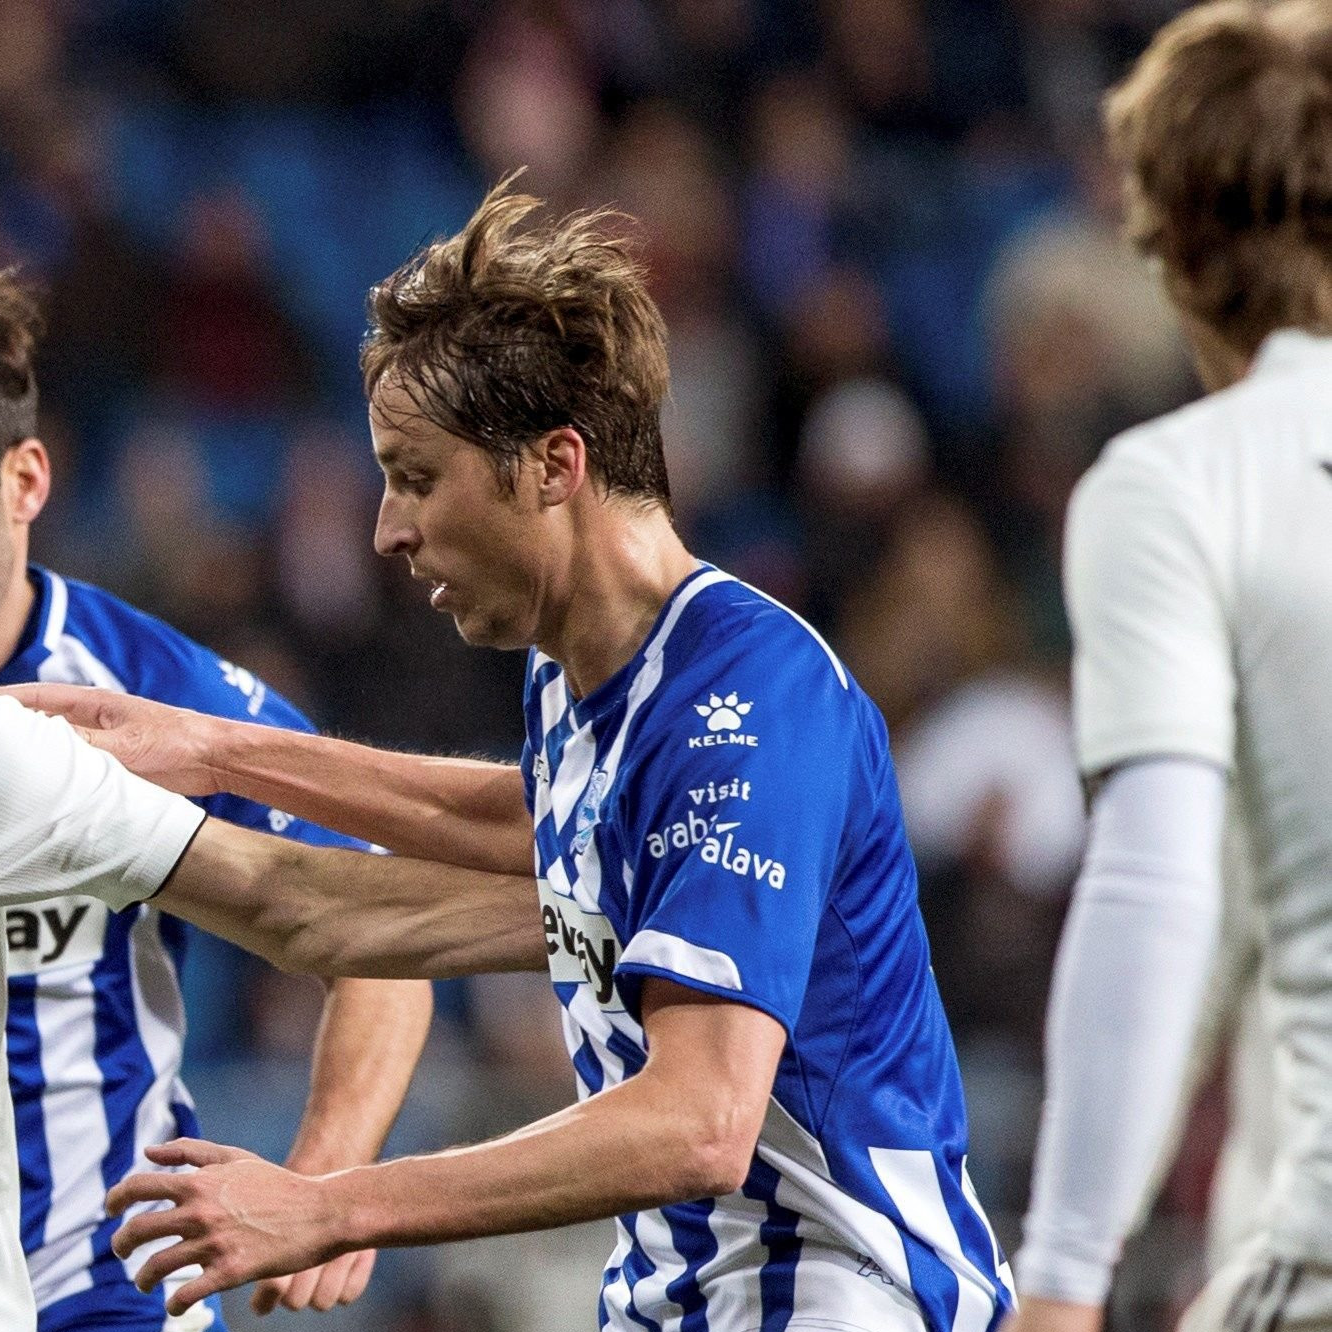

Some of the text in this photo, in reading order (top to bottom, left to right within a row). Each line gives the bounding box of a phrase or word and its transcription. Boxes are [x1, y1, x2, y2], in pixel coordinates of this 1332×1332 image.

[688, 733, 759, 748] KELME
[688, 778, 752, 806] visit
[646, 810, 718, 859] arab
